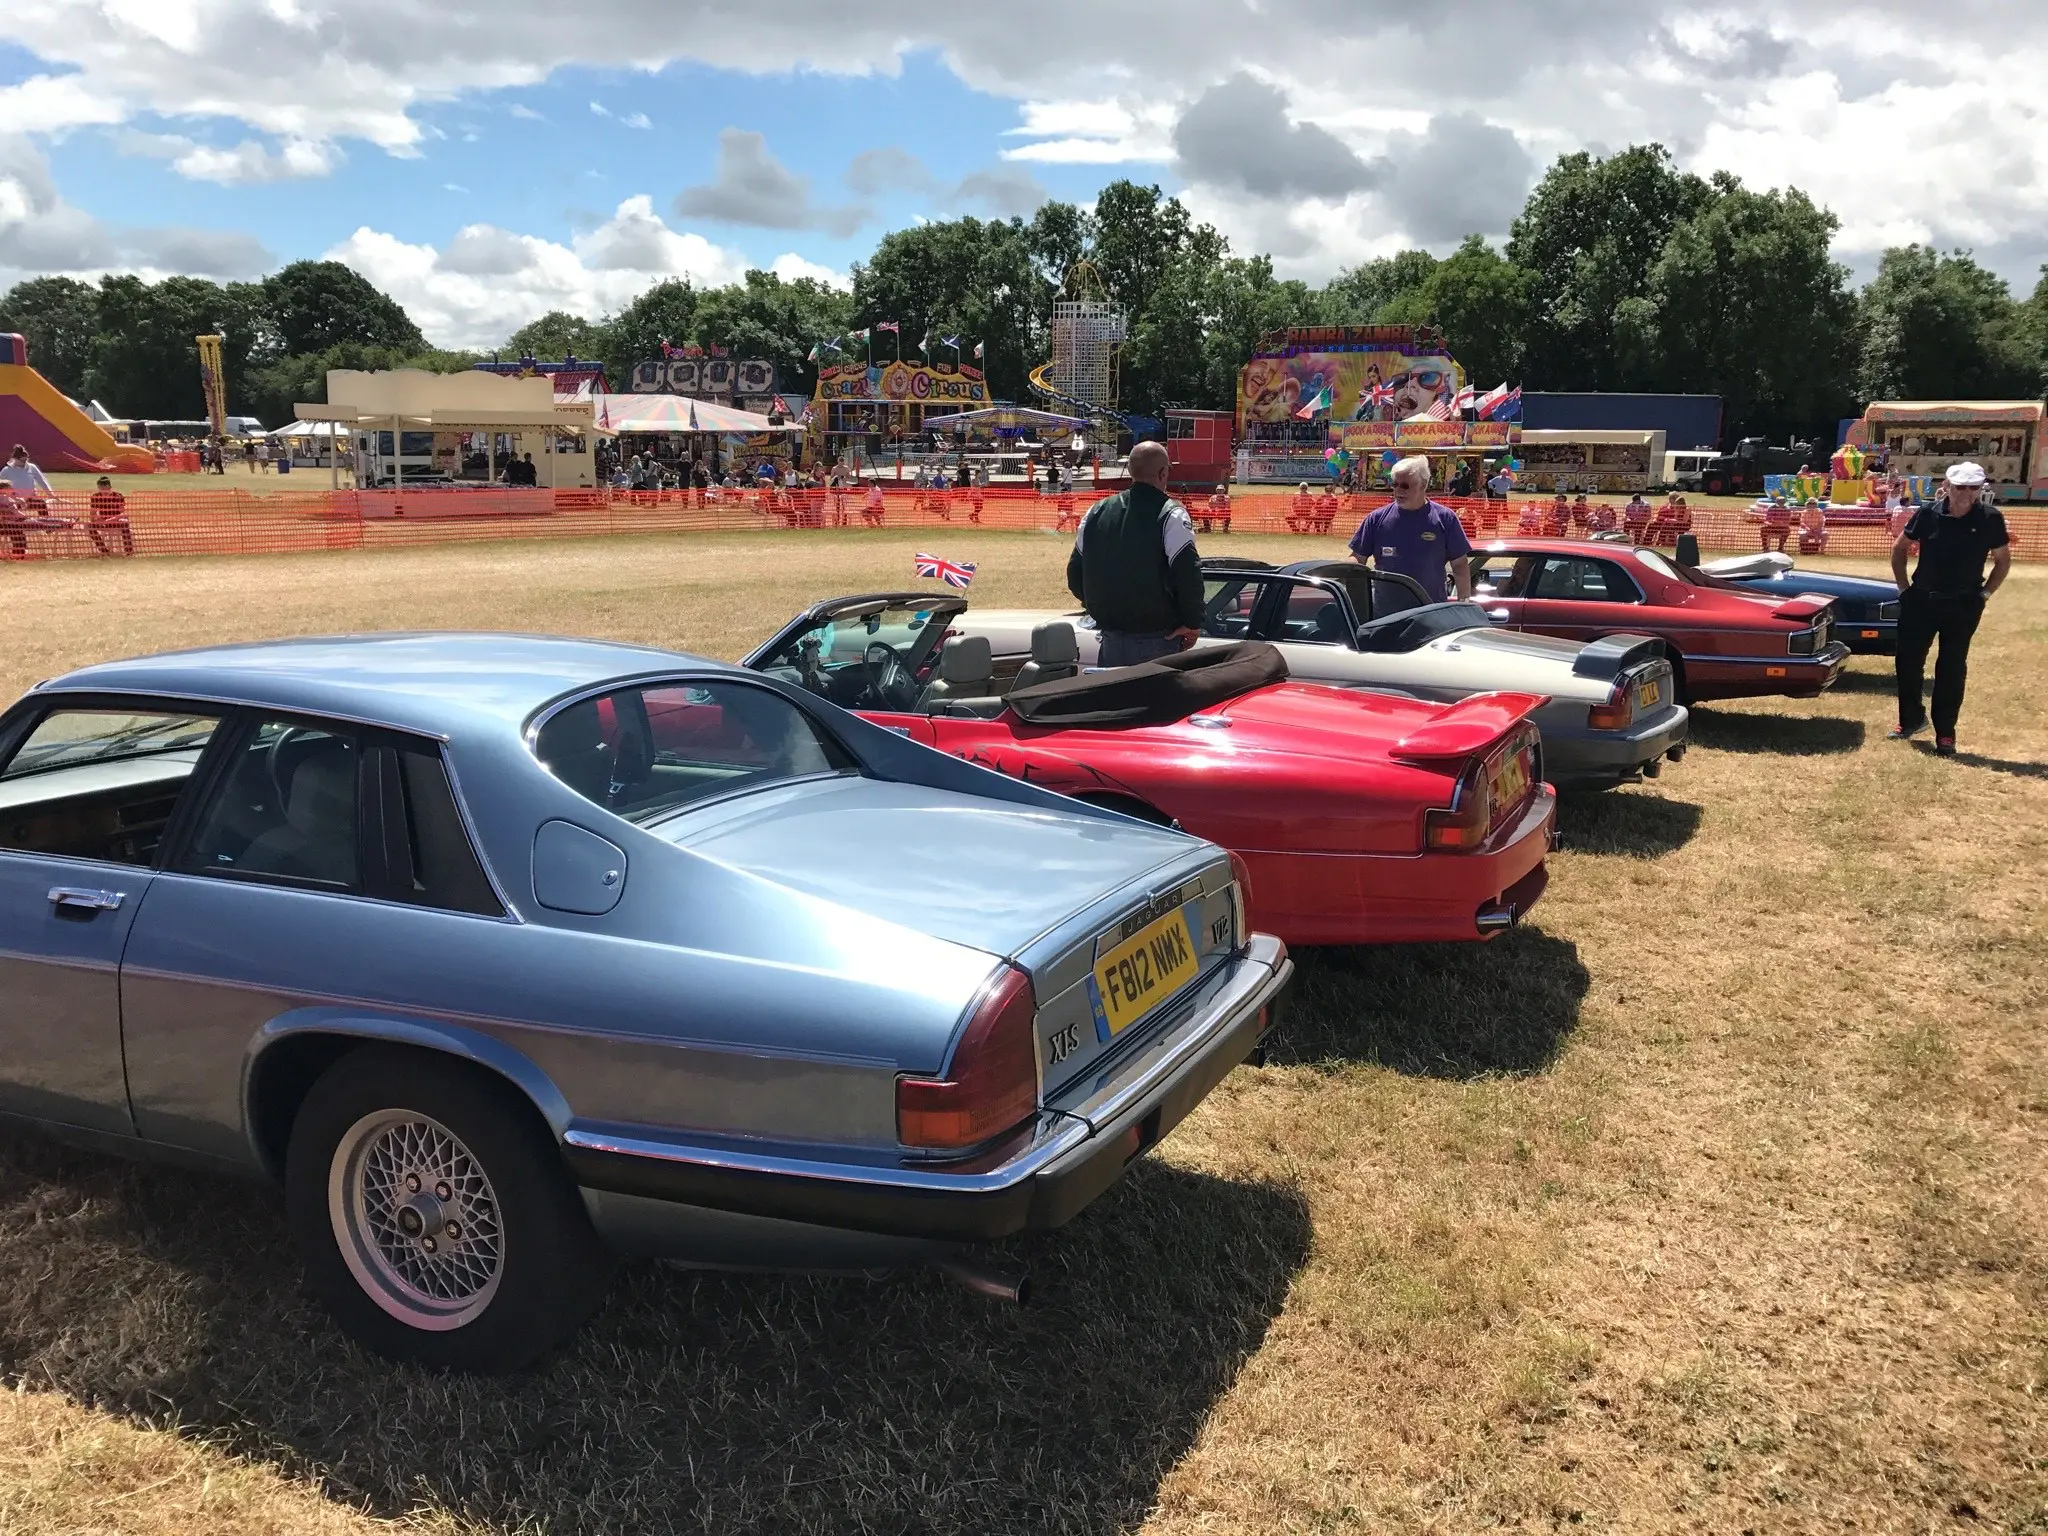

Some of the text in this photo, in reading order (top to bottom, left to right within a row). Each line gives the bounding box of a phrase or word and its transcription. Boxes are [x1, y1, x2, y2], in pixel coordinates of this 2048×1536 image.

[844, 360, 867, 373] CIRCUS
[821, 371, 984, 400] Crazy Circus
[1400, 423, 1464, 436] HOOK A DUCK
[1128, 896, 1179, 932] JAGUAR
[1212, 915, 1229, 944] V12
[1104, 922, 1188, 1013] F812 NMX
